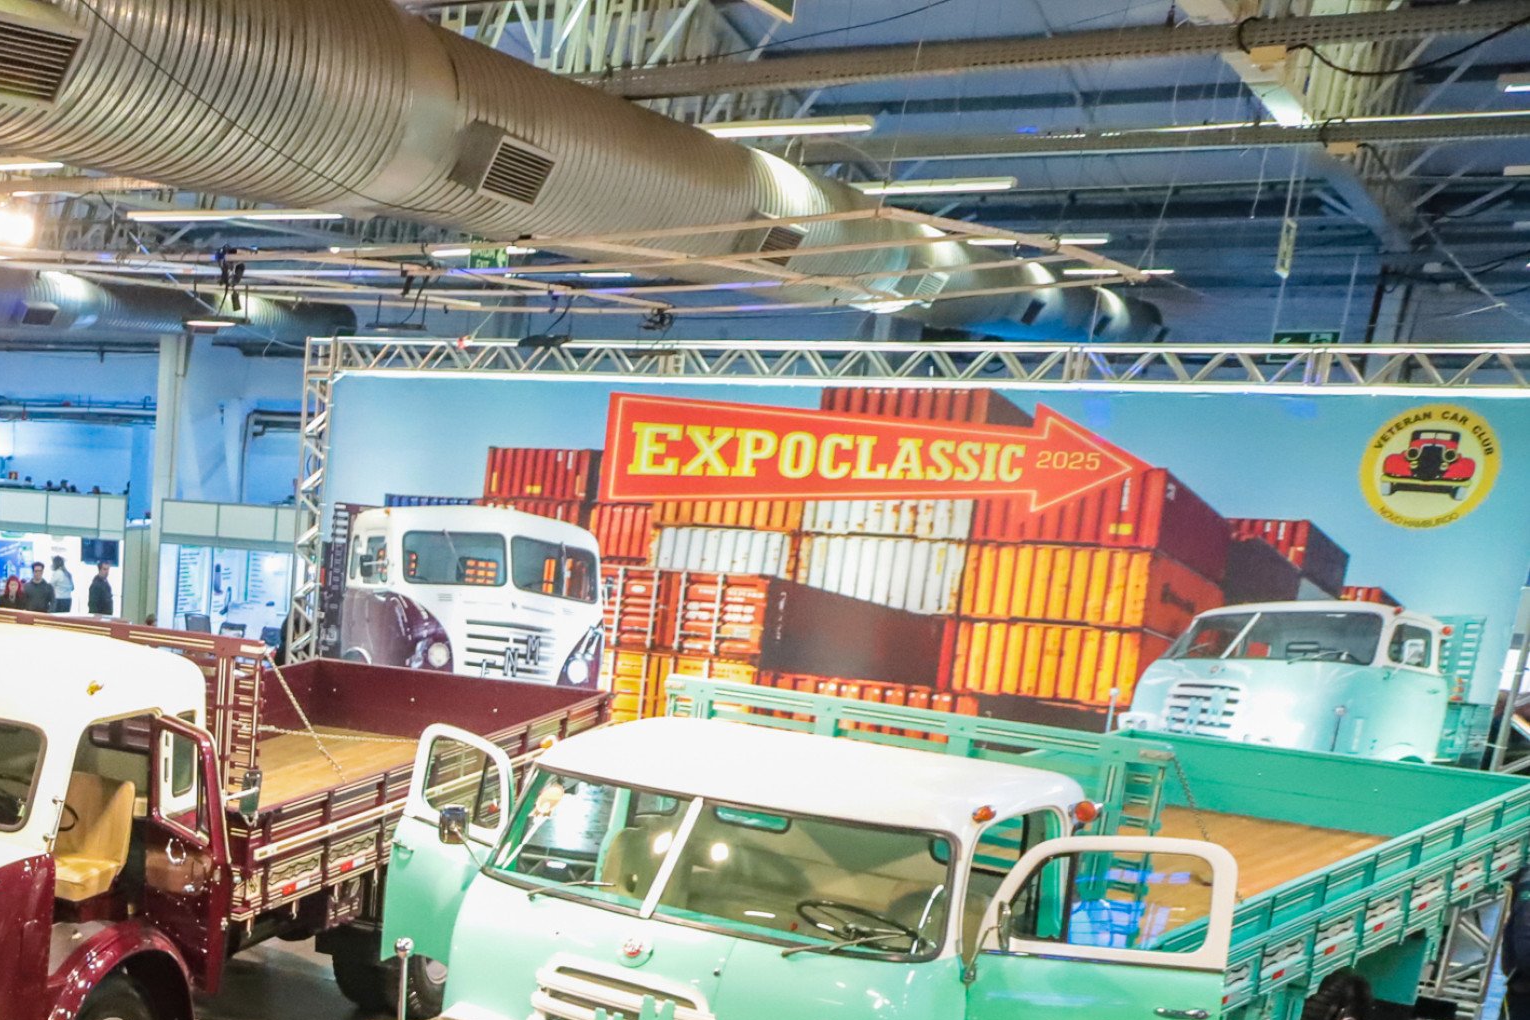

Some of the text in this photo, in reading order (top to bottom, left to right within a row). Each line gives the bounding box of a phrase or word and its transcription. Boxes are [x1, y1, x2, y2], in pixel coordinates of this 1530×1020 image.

[627, 421, 1101, 483] EXPOCLASSIC 2025
[1373, 411, 1495, 456] VETERAN CAR CLUB
